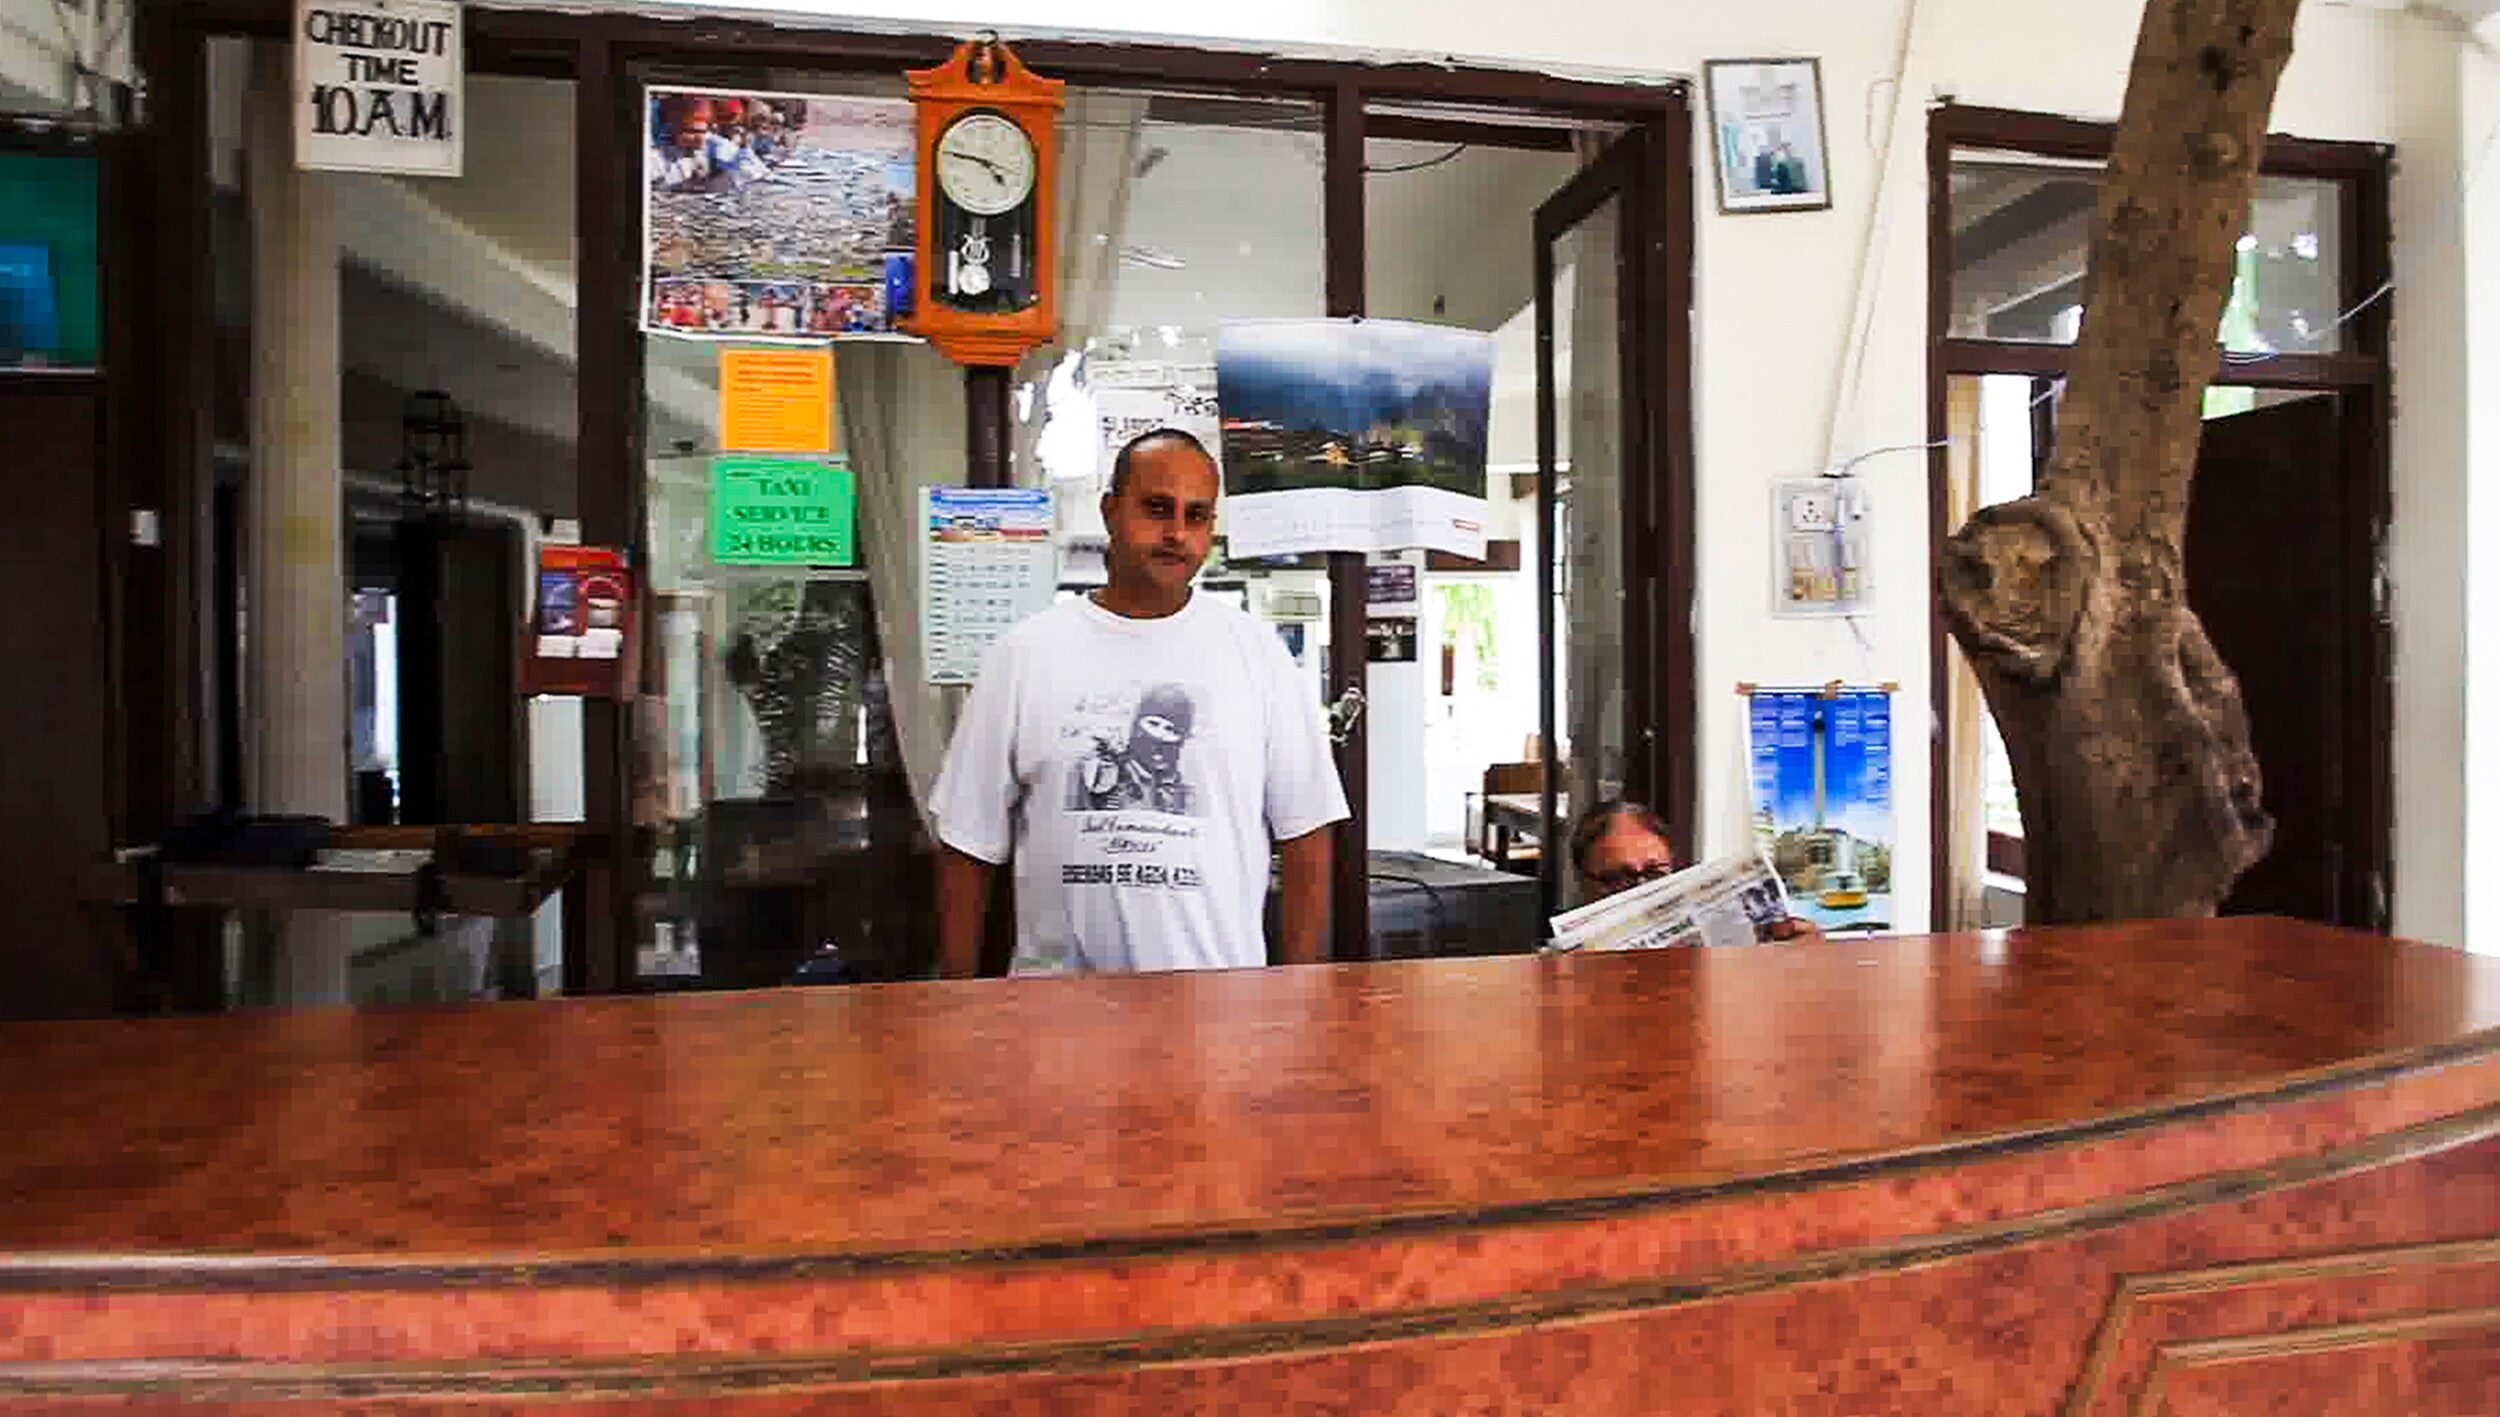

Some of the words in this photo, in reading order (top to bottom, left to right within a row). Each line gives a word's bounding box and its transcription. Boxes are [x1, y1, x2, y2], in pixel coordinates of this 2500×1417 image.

[307, 9, 452, 56] CHECKOUT
[340, 53, 418, 86] TIME
[759, 477, 818, 496] TAXI
[732, 505, 830, 524] SERVICE
[758, 535, 841, 553] HOURS
